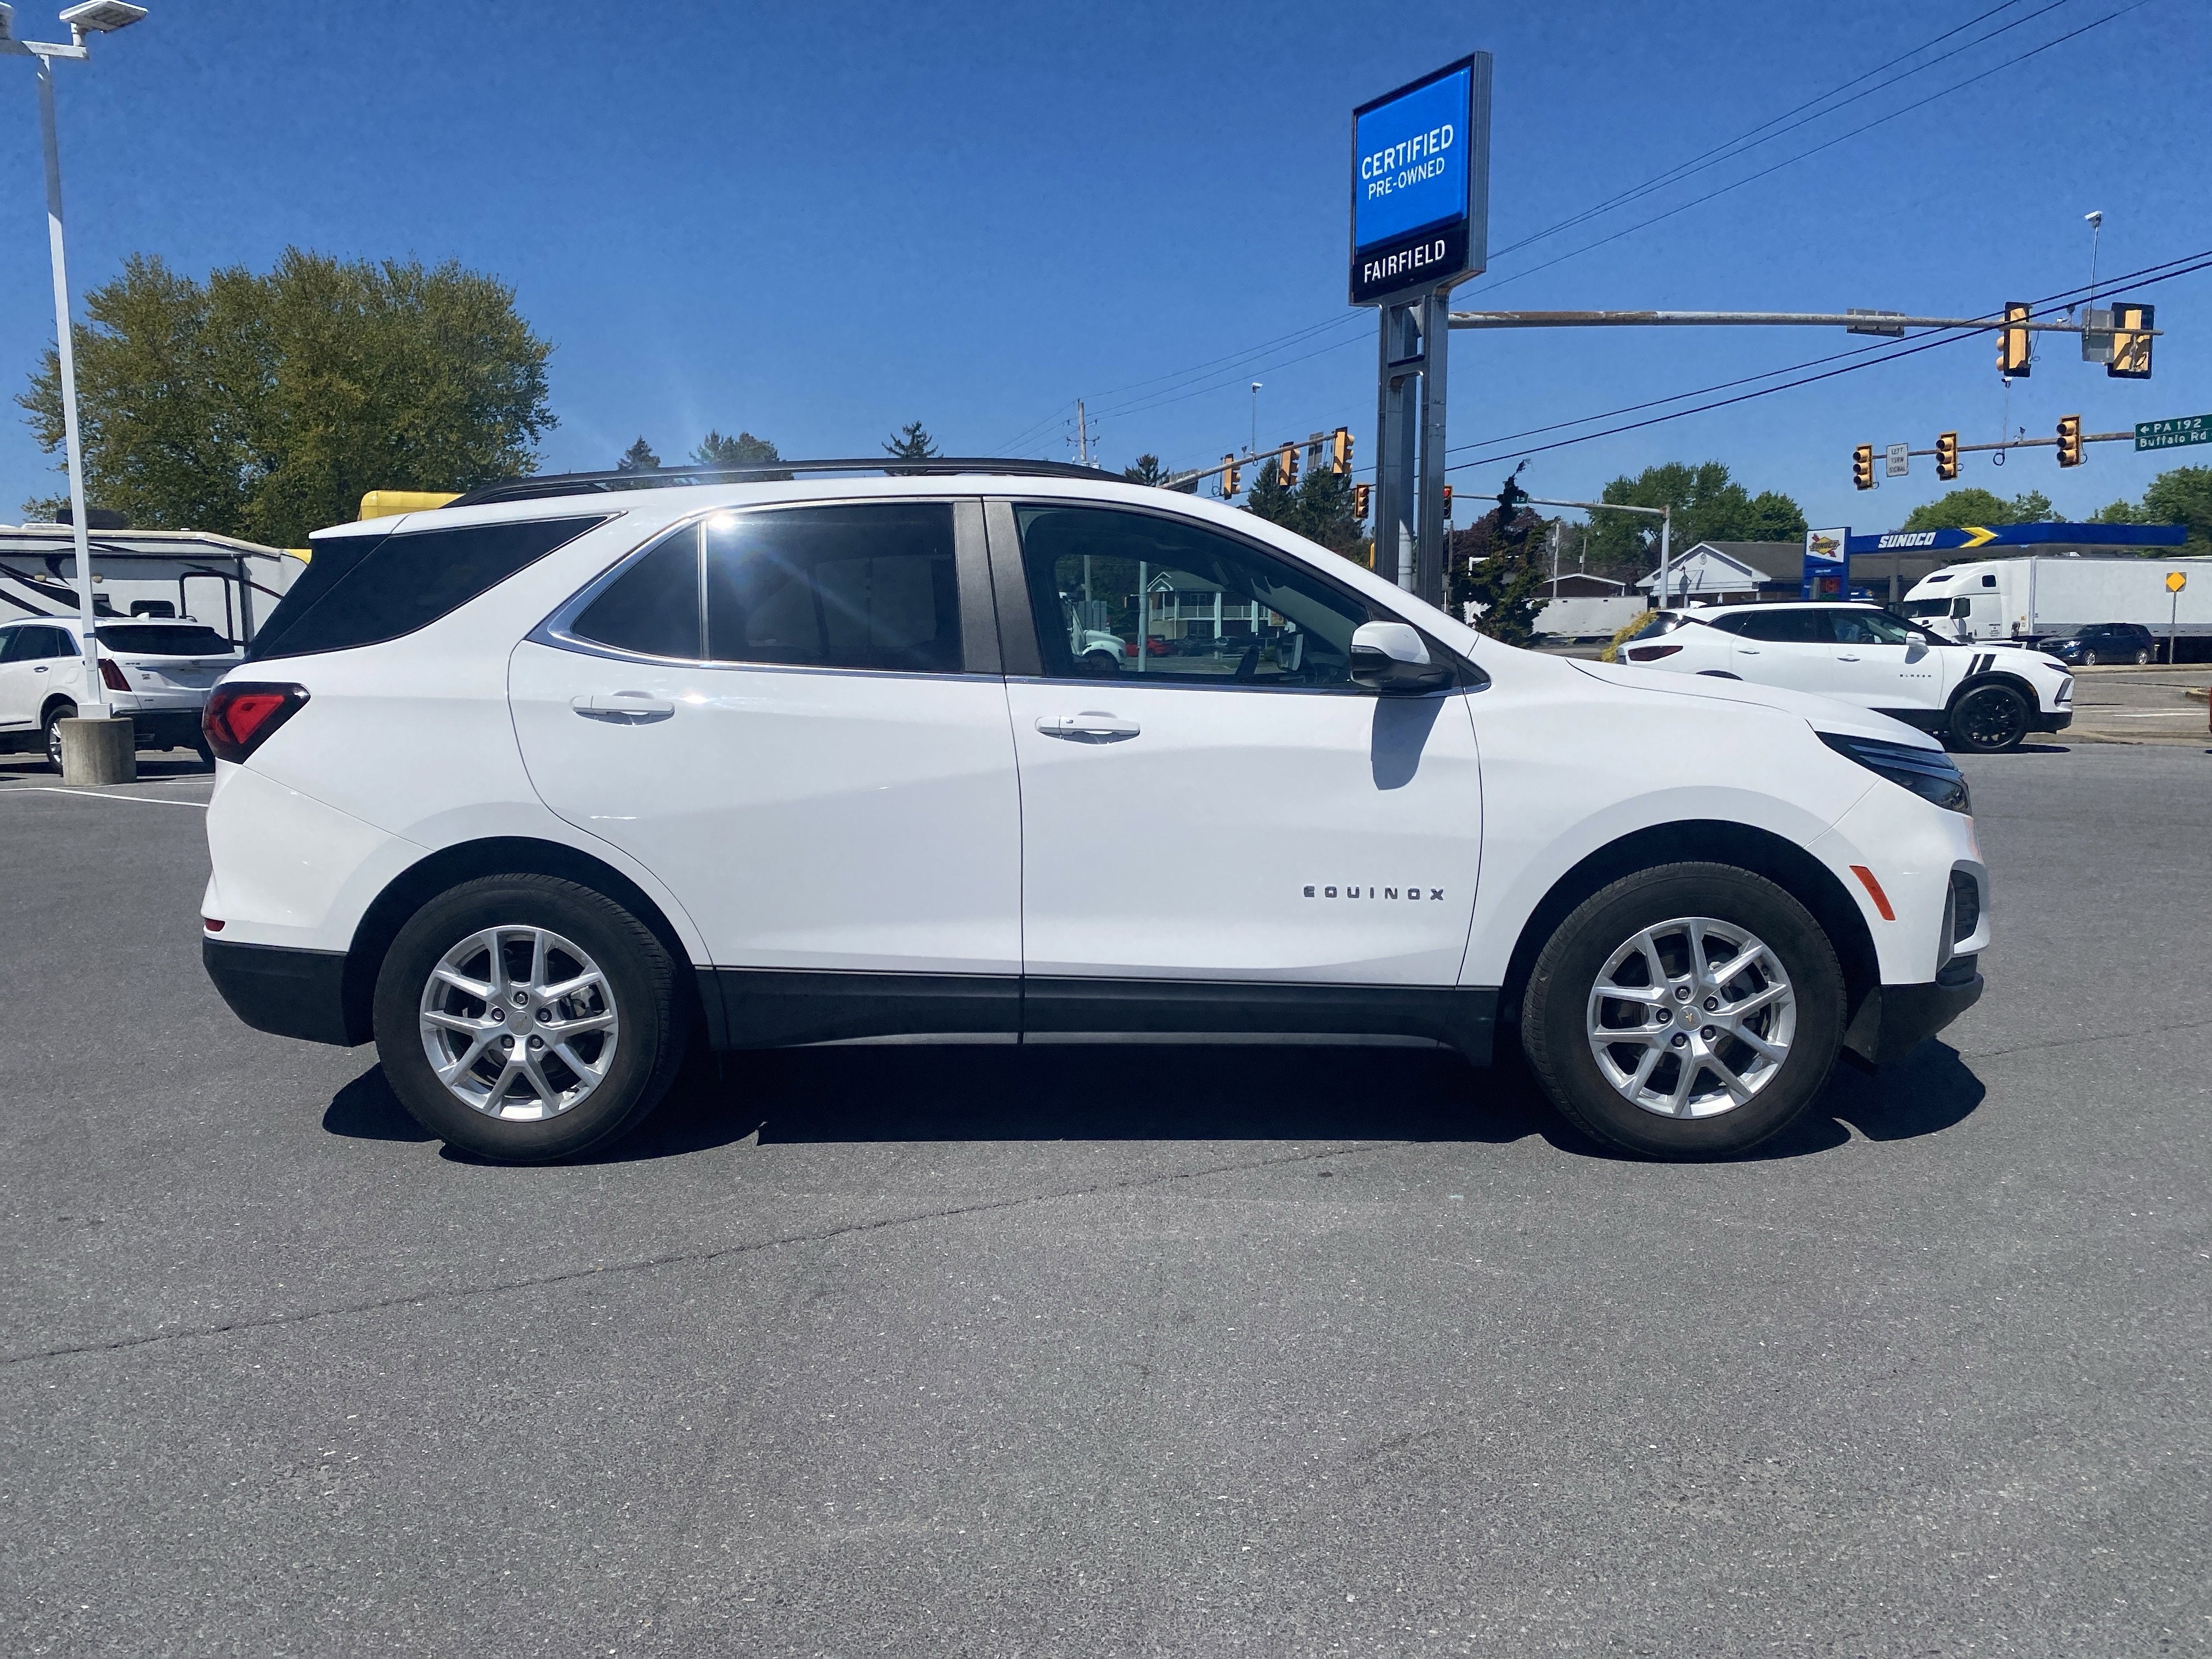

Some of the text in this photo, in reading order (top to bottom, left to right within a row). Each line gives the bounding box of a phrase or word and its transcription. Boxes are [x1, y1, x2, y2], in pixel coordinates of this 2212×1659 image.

[1362, 125, 1453, 179] CERTIFIED
[1368, 157, 1444, 200] PRE-OWNED
[1364, 240, 1445, 283] FAIRFIELD
[2154, 419, 2201, 433] PA 192
[2140, 431, 2206, 447] Buffalo Rd
[1878, 532, 1936, 548] SUNOCO
[1304, 886, 1443, 901] EQUINOX
